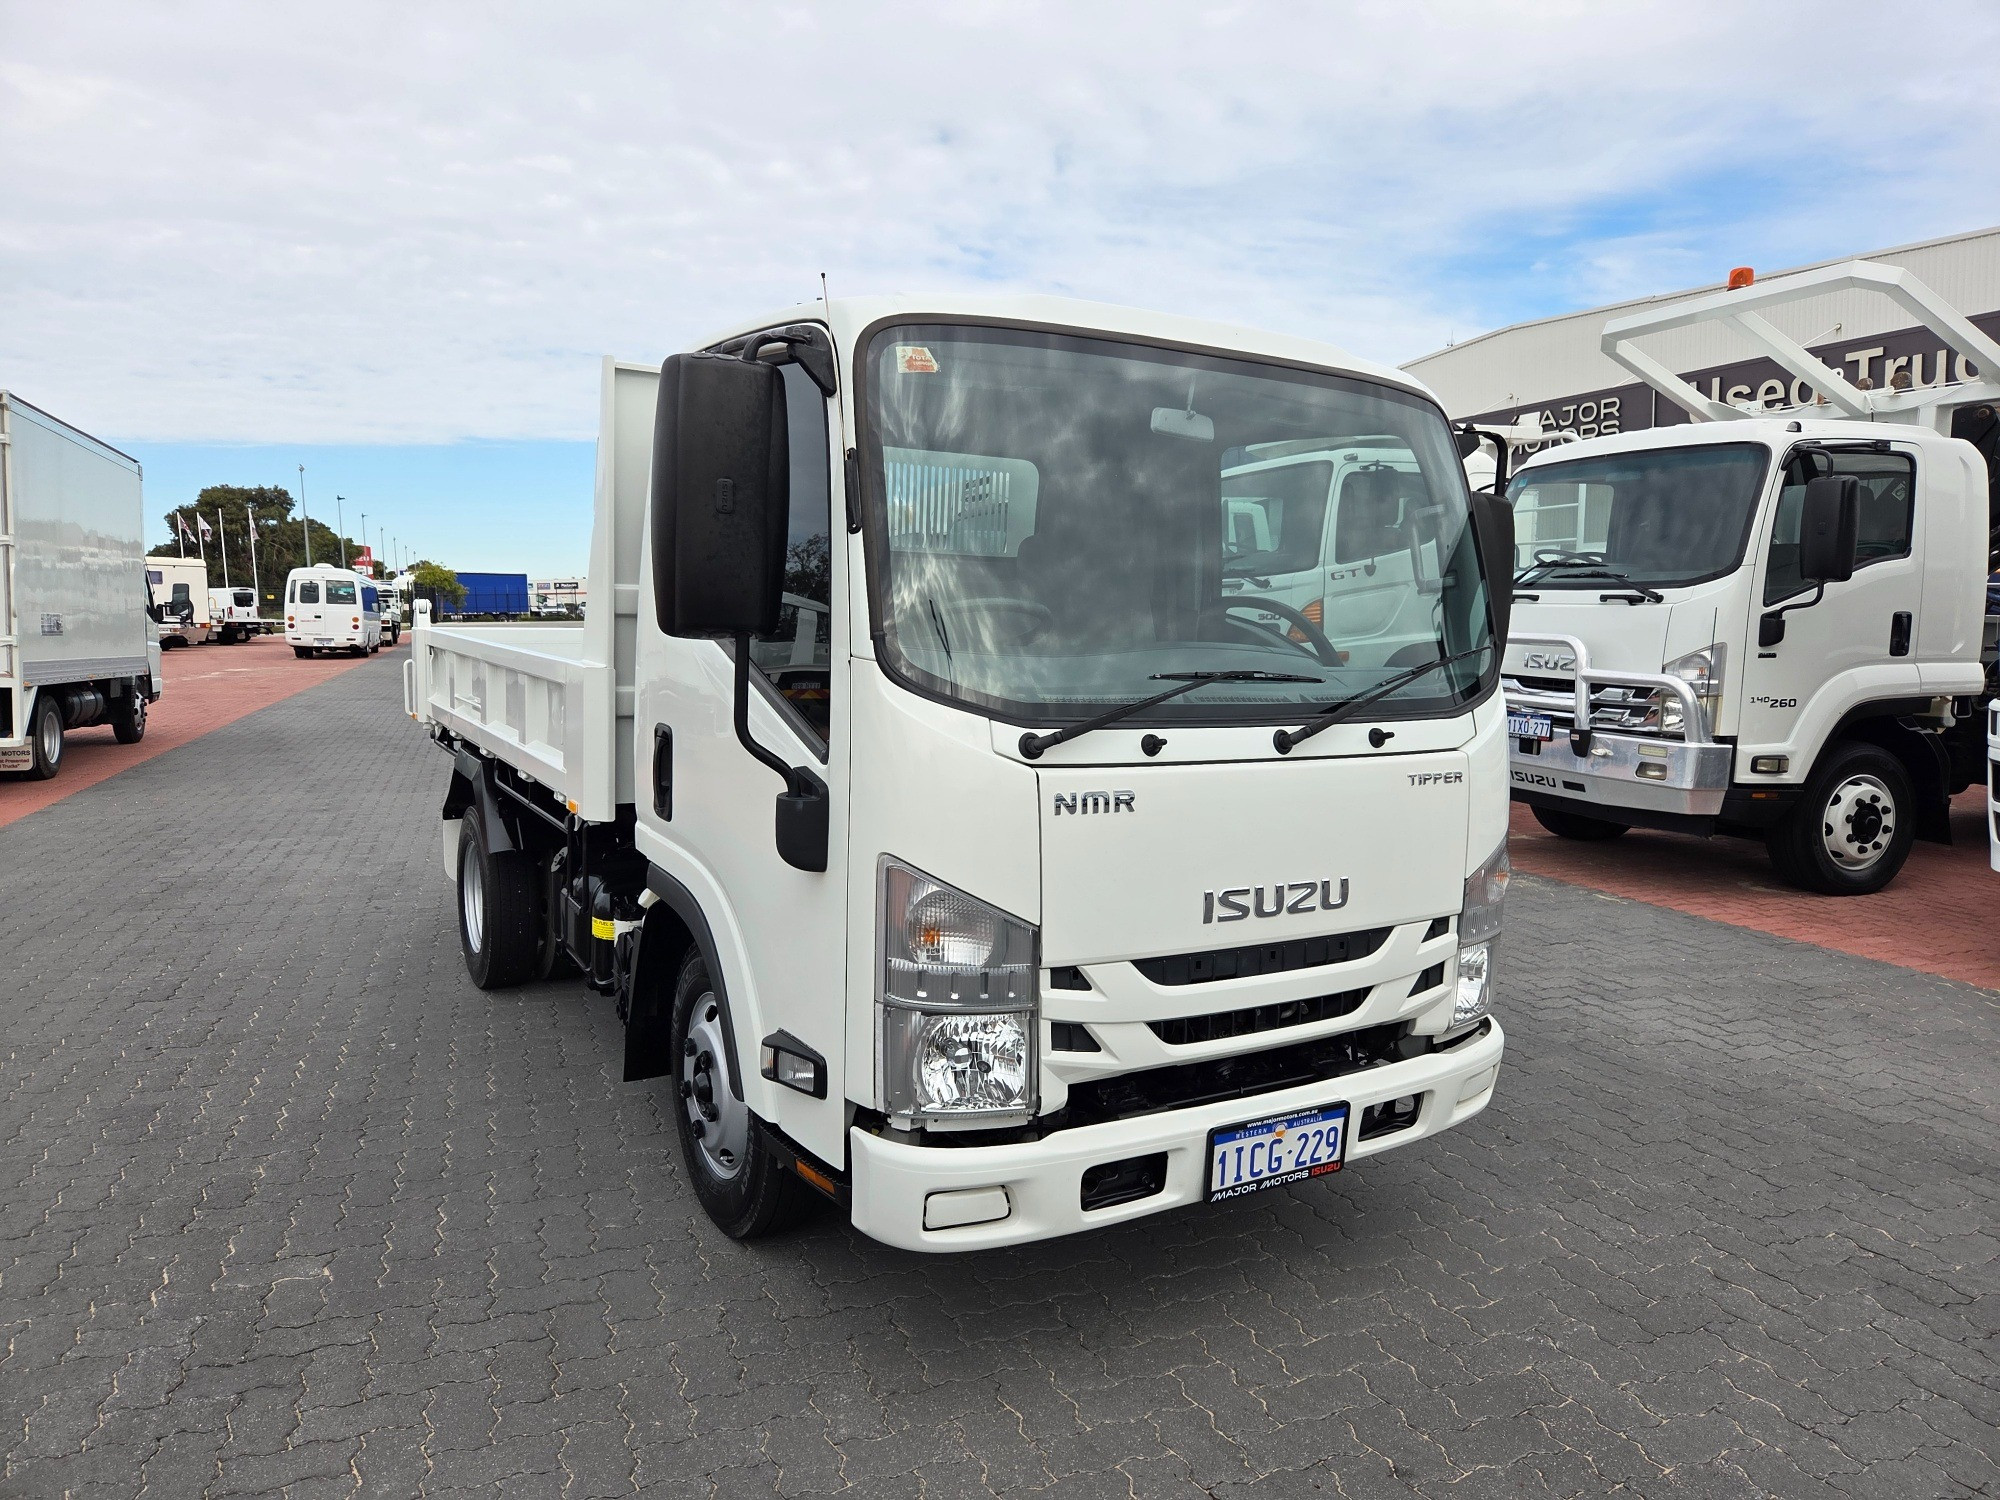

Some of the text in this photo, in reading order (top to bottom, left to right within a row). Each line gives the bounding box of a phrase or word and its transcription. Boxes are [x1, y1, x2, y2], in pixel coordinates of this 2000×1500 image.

[1523, 652, 1576, 672] ISUZ
[1770, 698, 1797, 708] 260
[1407, 771, 1464, 786] TIPPER
[1509, 770, 1557, 788] ISUZU
[1053, 789, 1136, 816] NMR
[1202, 876, 1350, 924] ISUZU
[1235, 1115, 1322, 1139] WESTERN AUSTRALIA
[1246, 1108, 1319, 1128] www.majormotors.com.au
[1210, 1161, 1341, 1203] MAJOR MOTORS ISUZU
